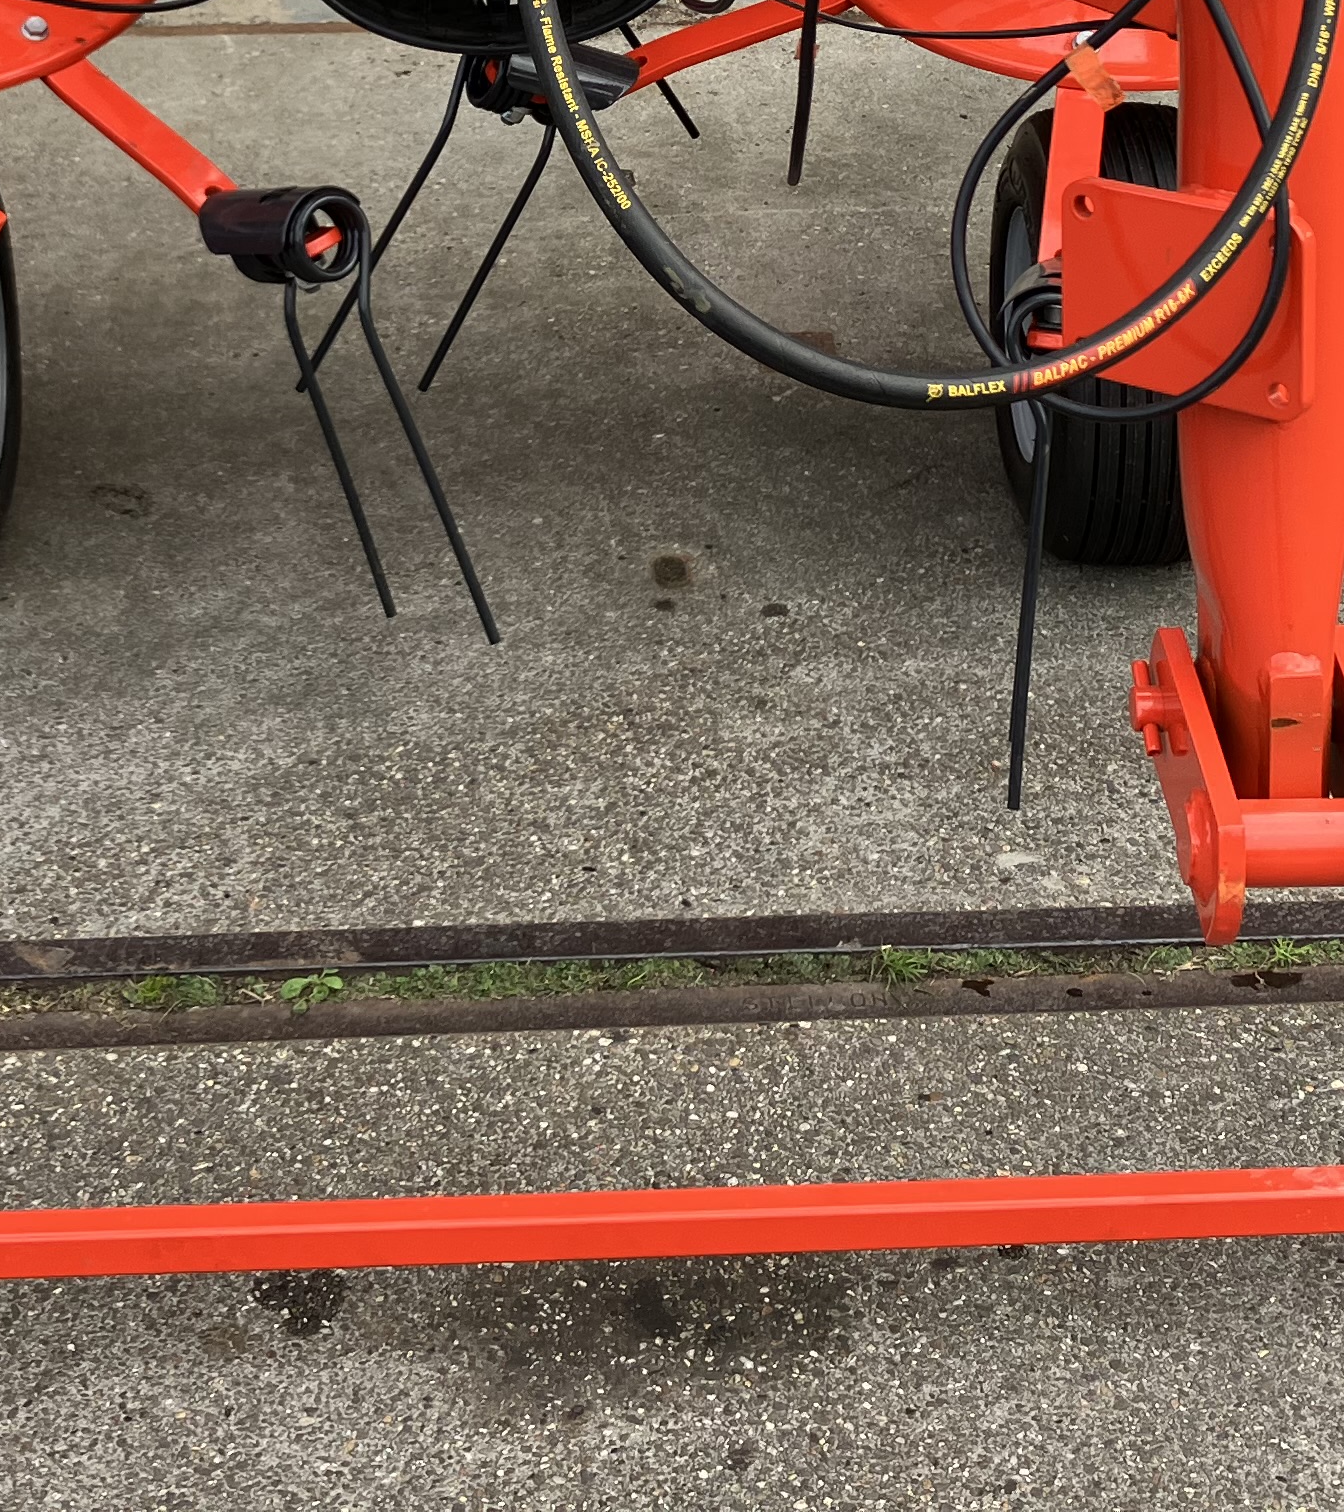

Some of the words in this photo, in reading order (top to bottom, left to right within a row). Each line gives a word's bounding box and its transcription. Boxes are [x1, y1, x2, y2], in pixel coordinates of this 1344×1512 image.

[540, 16, 557, 54] Flame
[551, 55, 579, 113] Resistant
[594, 157, 632, 210] IC-252/00
[947, 379, 1006, 397] BALFLEX
[1032, 354, 1088, 386] BALPAC
[1096, 316, 1155, 360] PREMIUM
[1200, 233, 1243, 282] EXCEEDS
